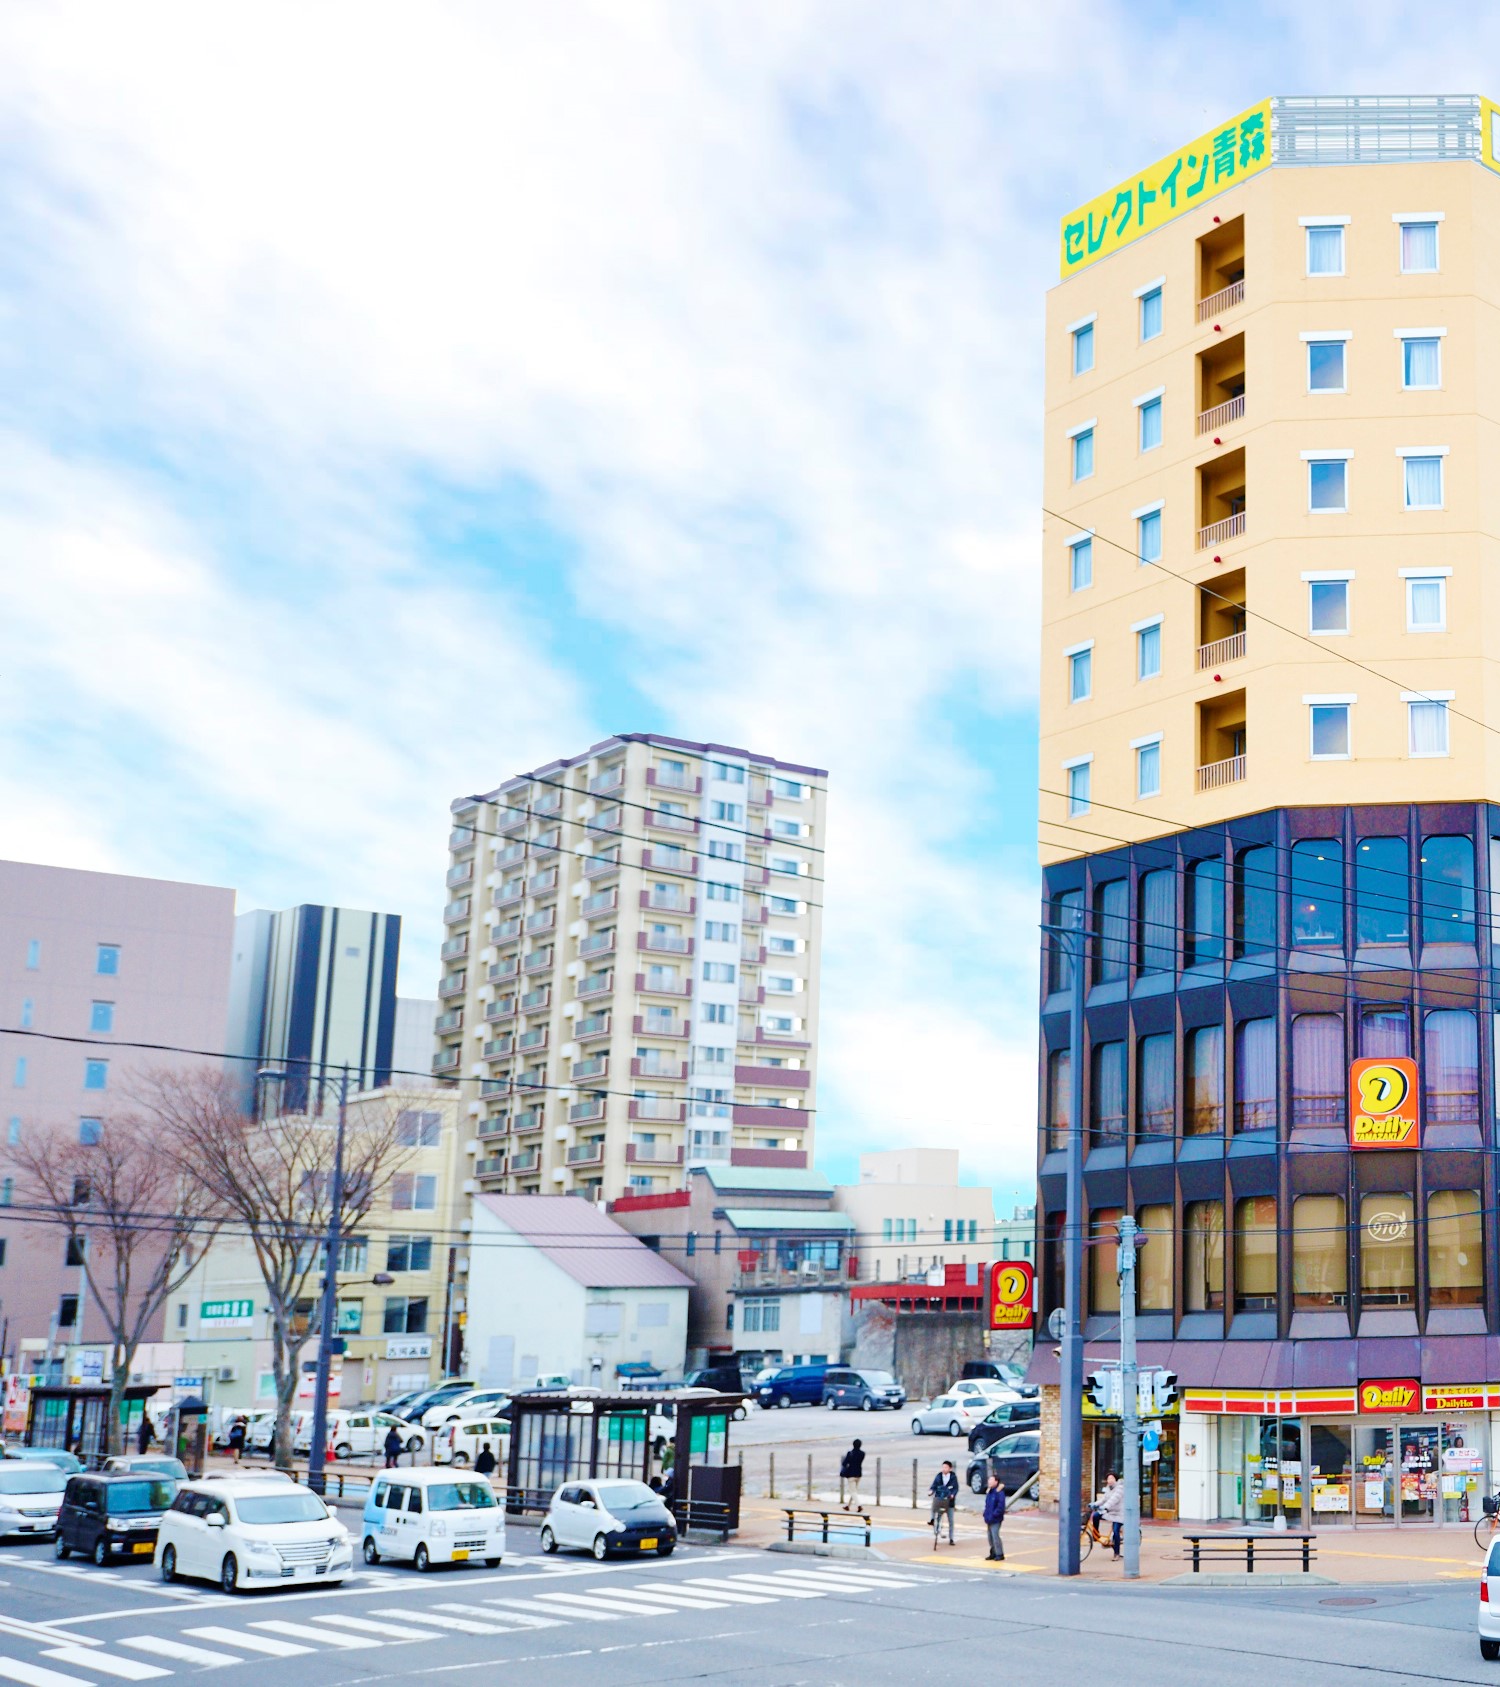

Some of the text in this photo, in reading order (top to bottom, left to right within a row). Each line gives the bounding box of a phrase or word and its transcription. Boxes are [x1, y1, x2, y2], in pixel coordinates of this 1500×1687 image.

[1064, 112, 1264, 265] セレクトイン青森
[1356, 1116, 1415, 1141] Daily
[1356, 1132, 1398, 1142] YAMAZAKI
[995, 1304, 1031, 1323] Daily
[1362, 1386, 1416, 1409] Daily
[1431, 1387, 1478, 1396] 焼きたてパン
[1436, 1398, 1474, 1409] DailyHot
[1362, 1455, 1386, 1466] Daily
